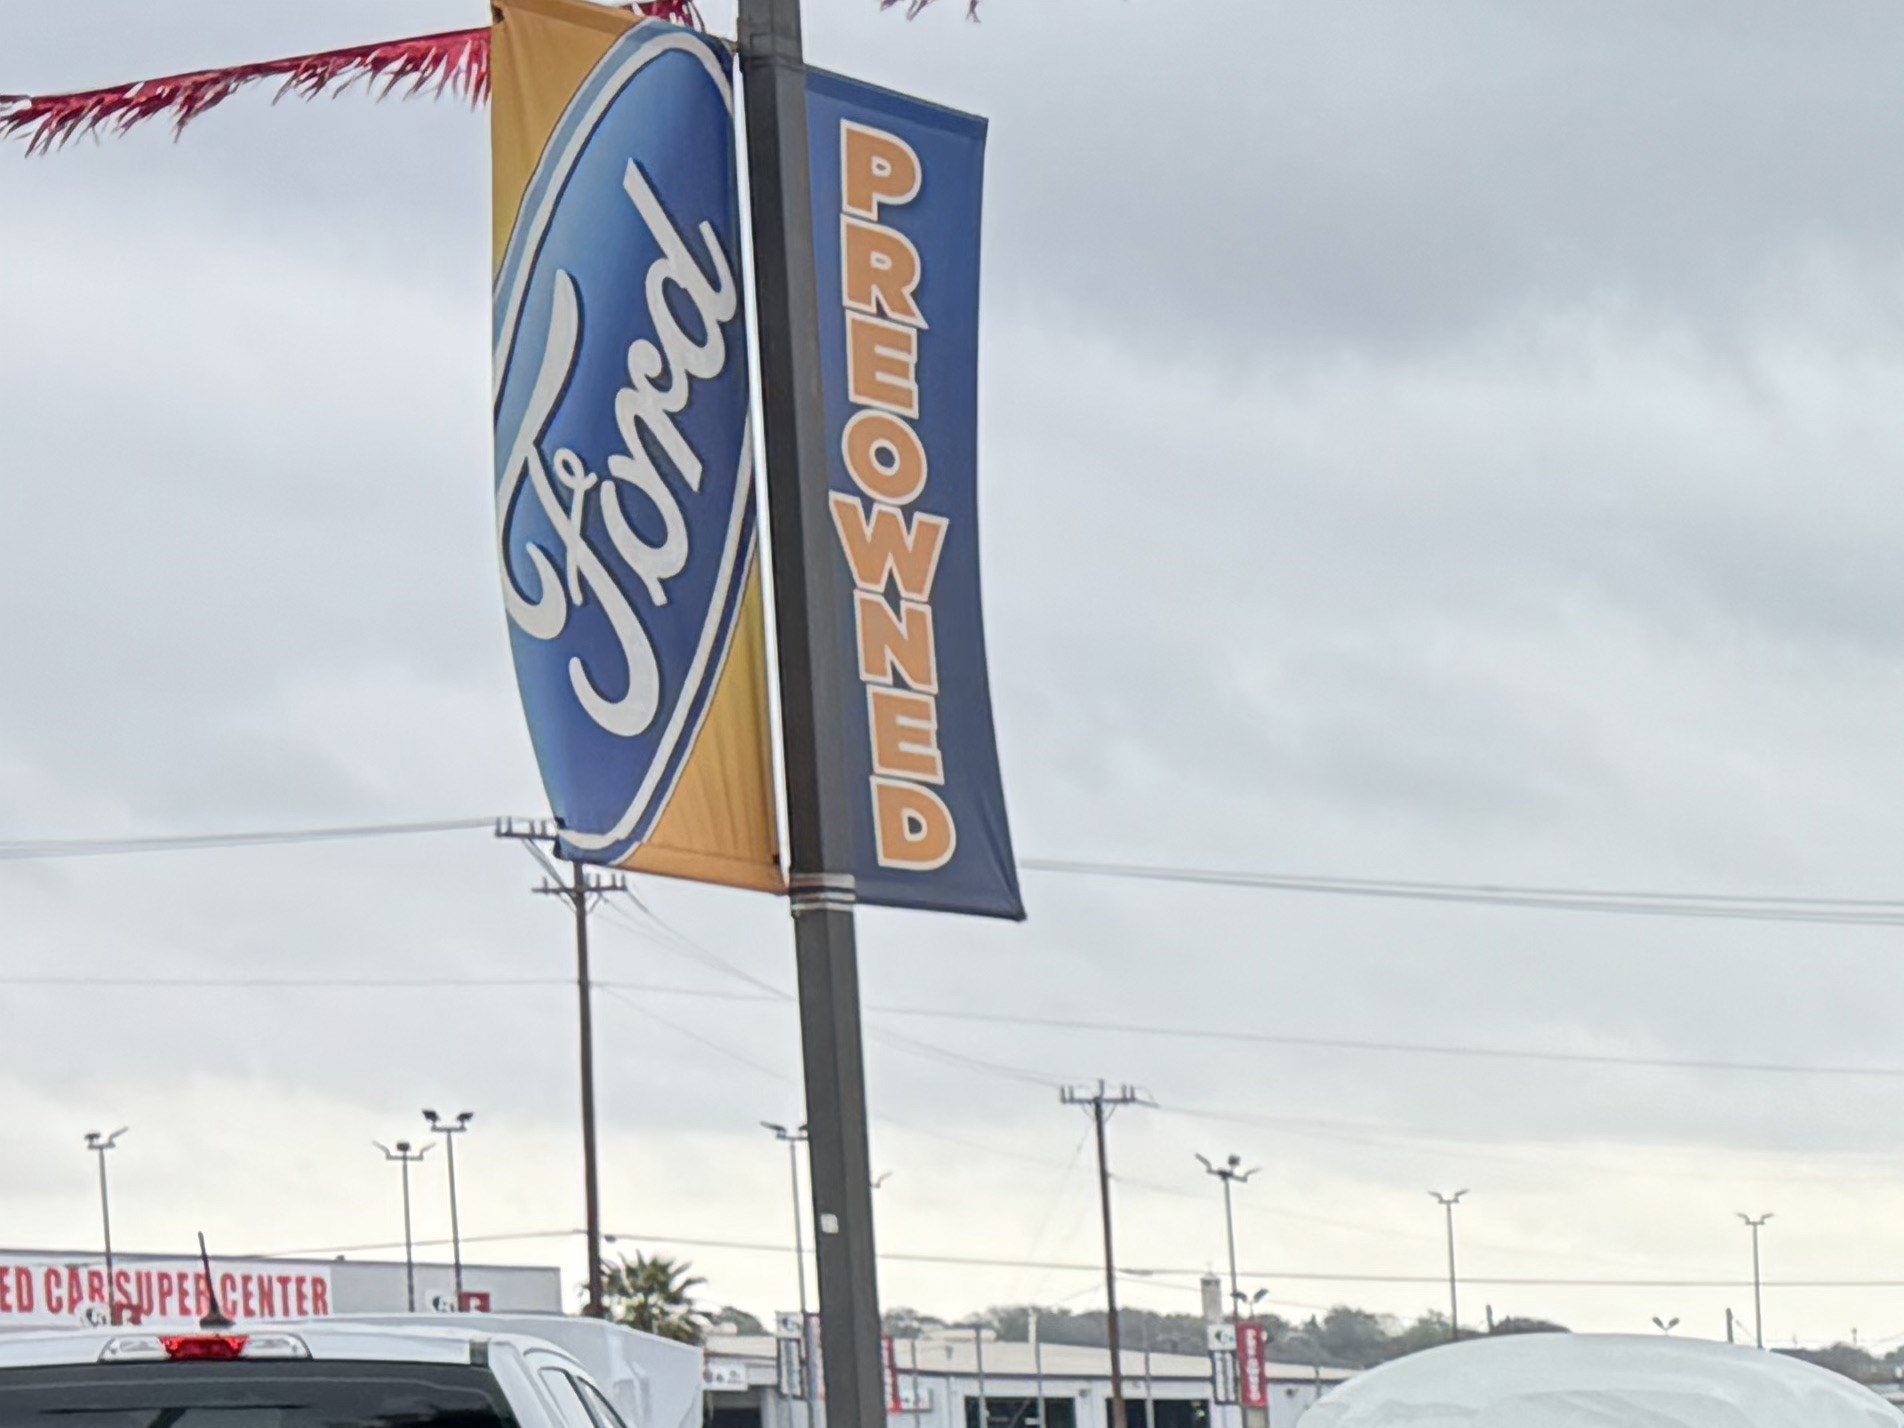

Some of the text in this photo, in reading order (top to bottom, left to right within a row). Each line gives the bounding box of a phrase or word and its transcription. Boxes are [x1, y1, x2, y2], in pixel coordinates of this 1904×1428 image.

[497, 156, 738, 738] Ford
[829, 118, 957, 872] PREOWNED
[45, 1267, 105, 1315] CAR
[115, 1269, 213, 1318] SUPER
[220, 1273, 330, 1318] CENTER
